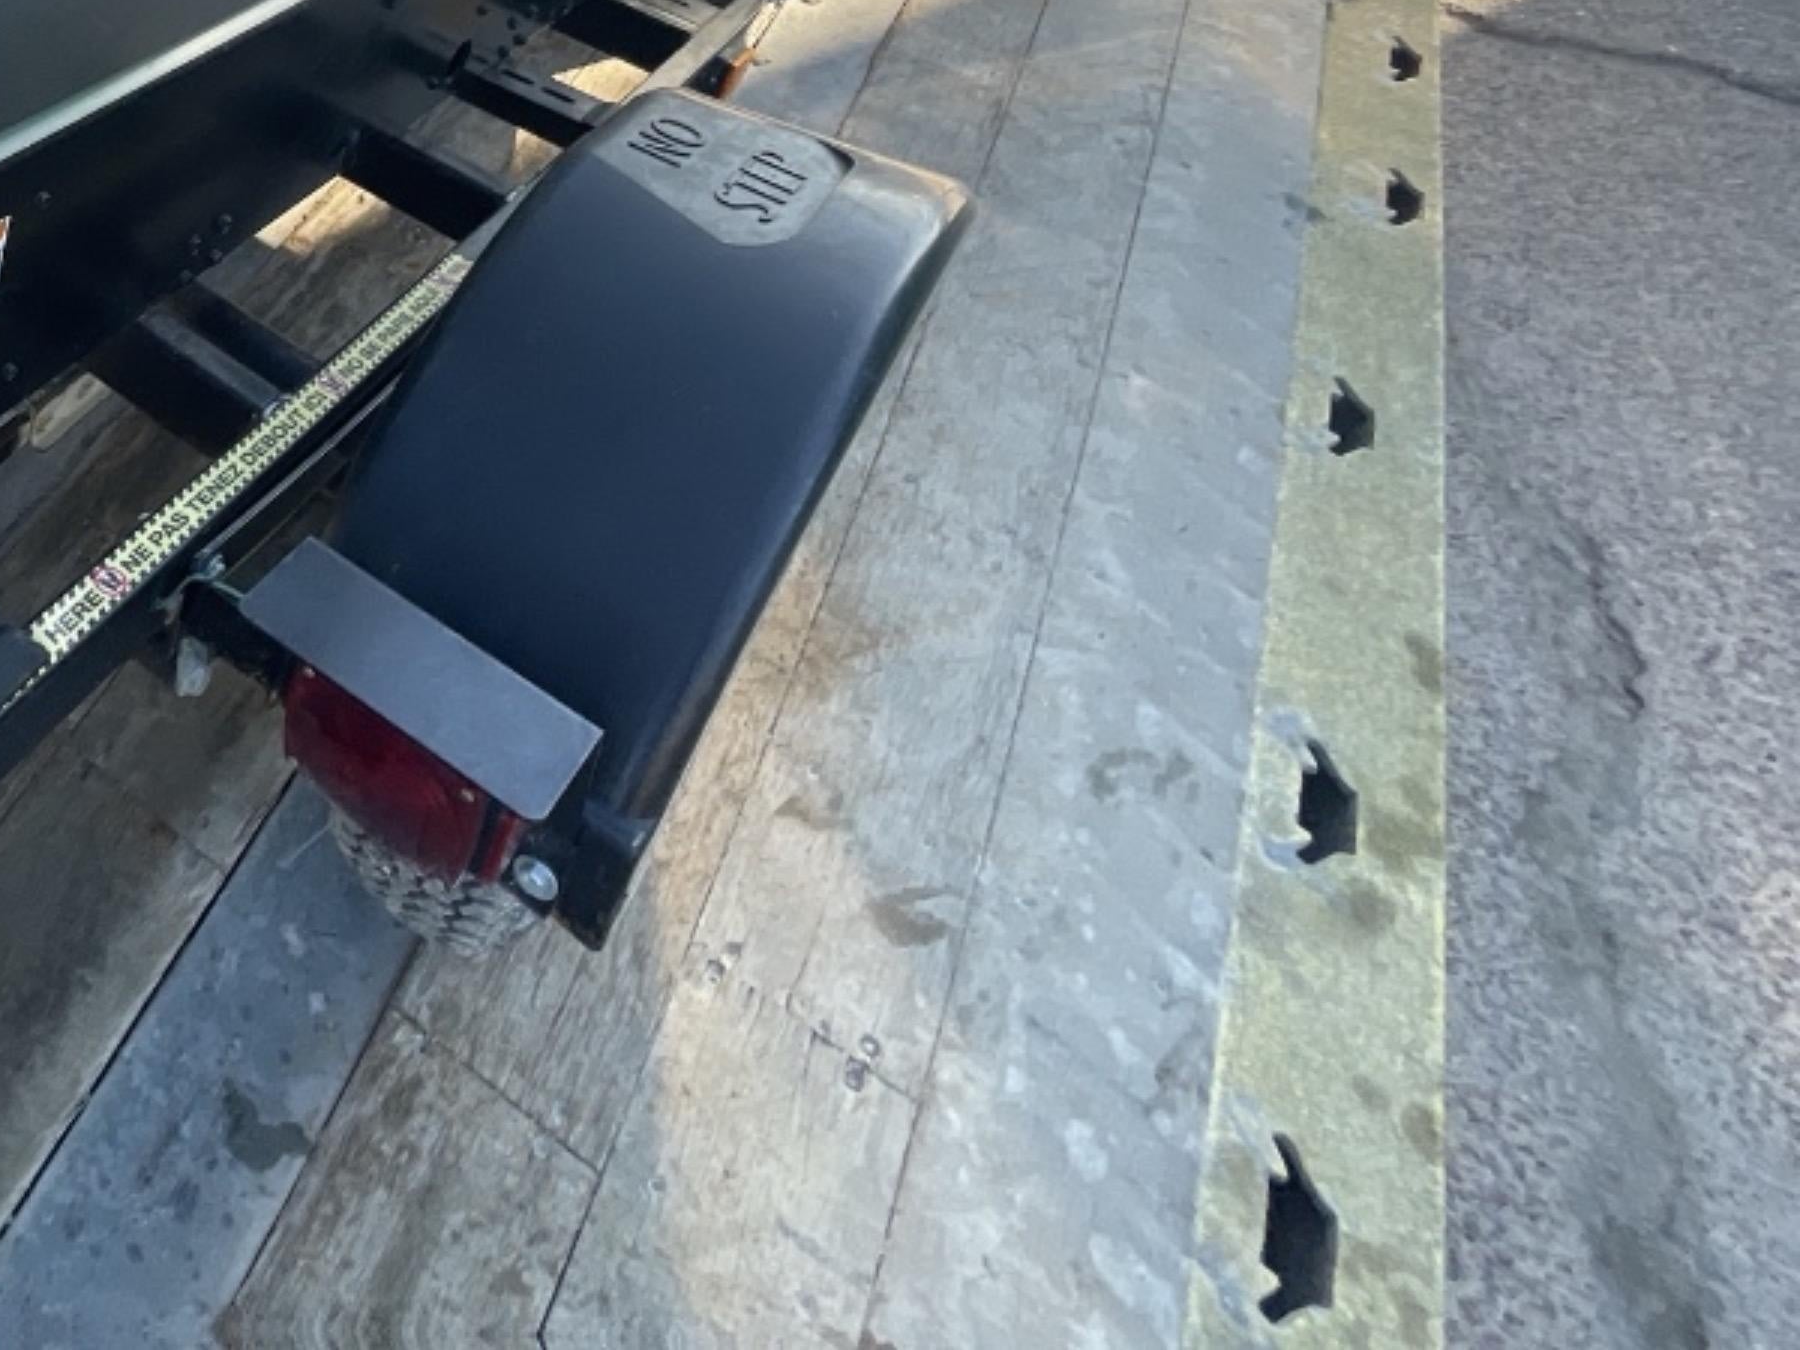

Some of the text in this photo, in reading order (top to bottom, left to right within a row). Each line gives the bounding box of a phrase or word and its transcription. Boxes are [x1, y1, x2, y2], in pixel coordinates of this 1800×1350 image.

[626, 117, 705, 170] NO
[712, 149, 809, 224] STEP
[120, 544, 153, 571] NE
[147, 512, 190, 547] PAS
[184, 462, 244, 513] TENEZ
